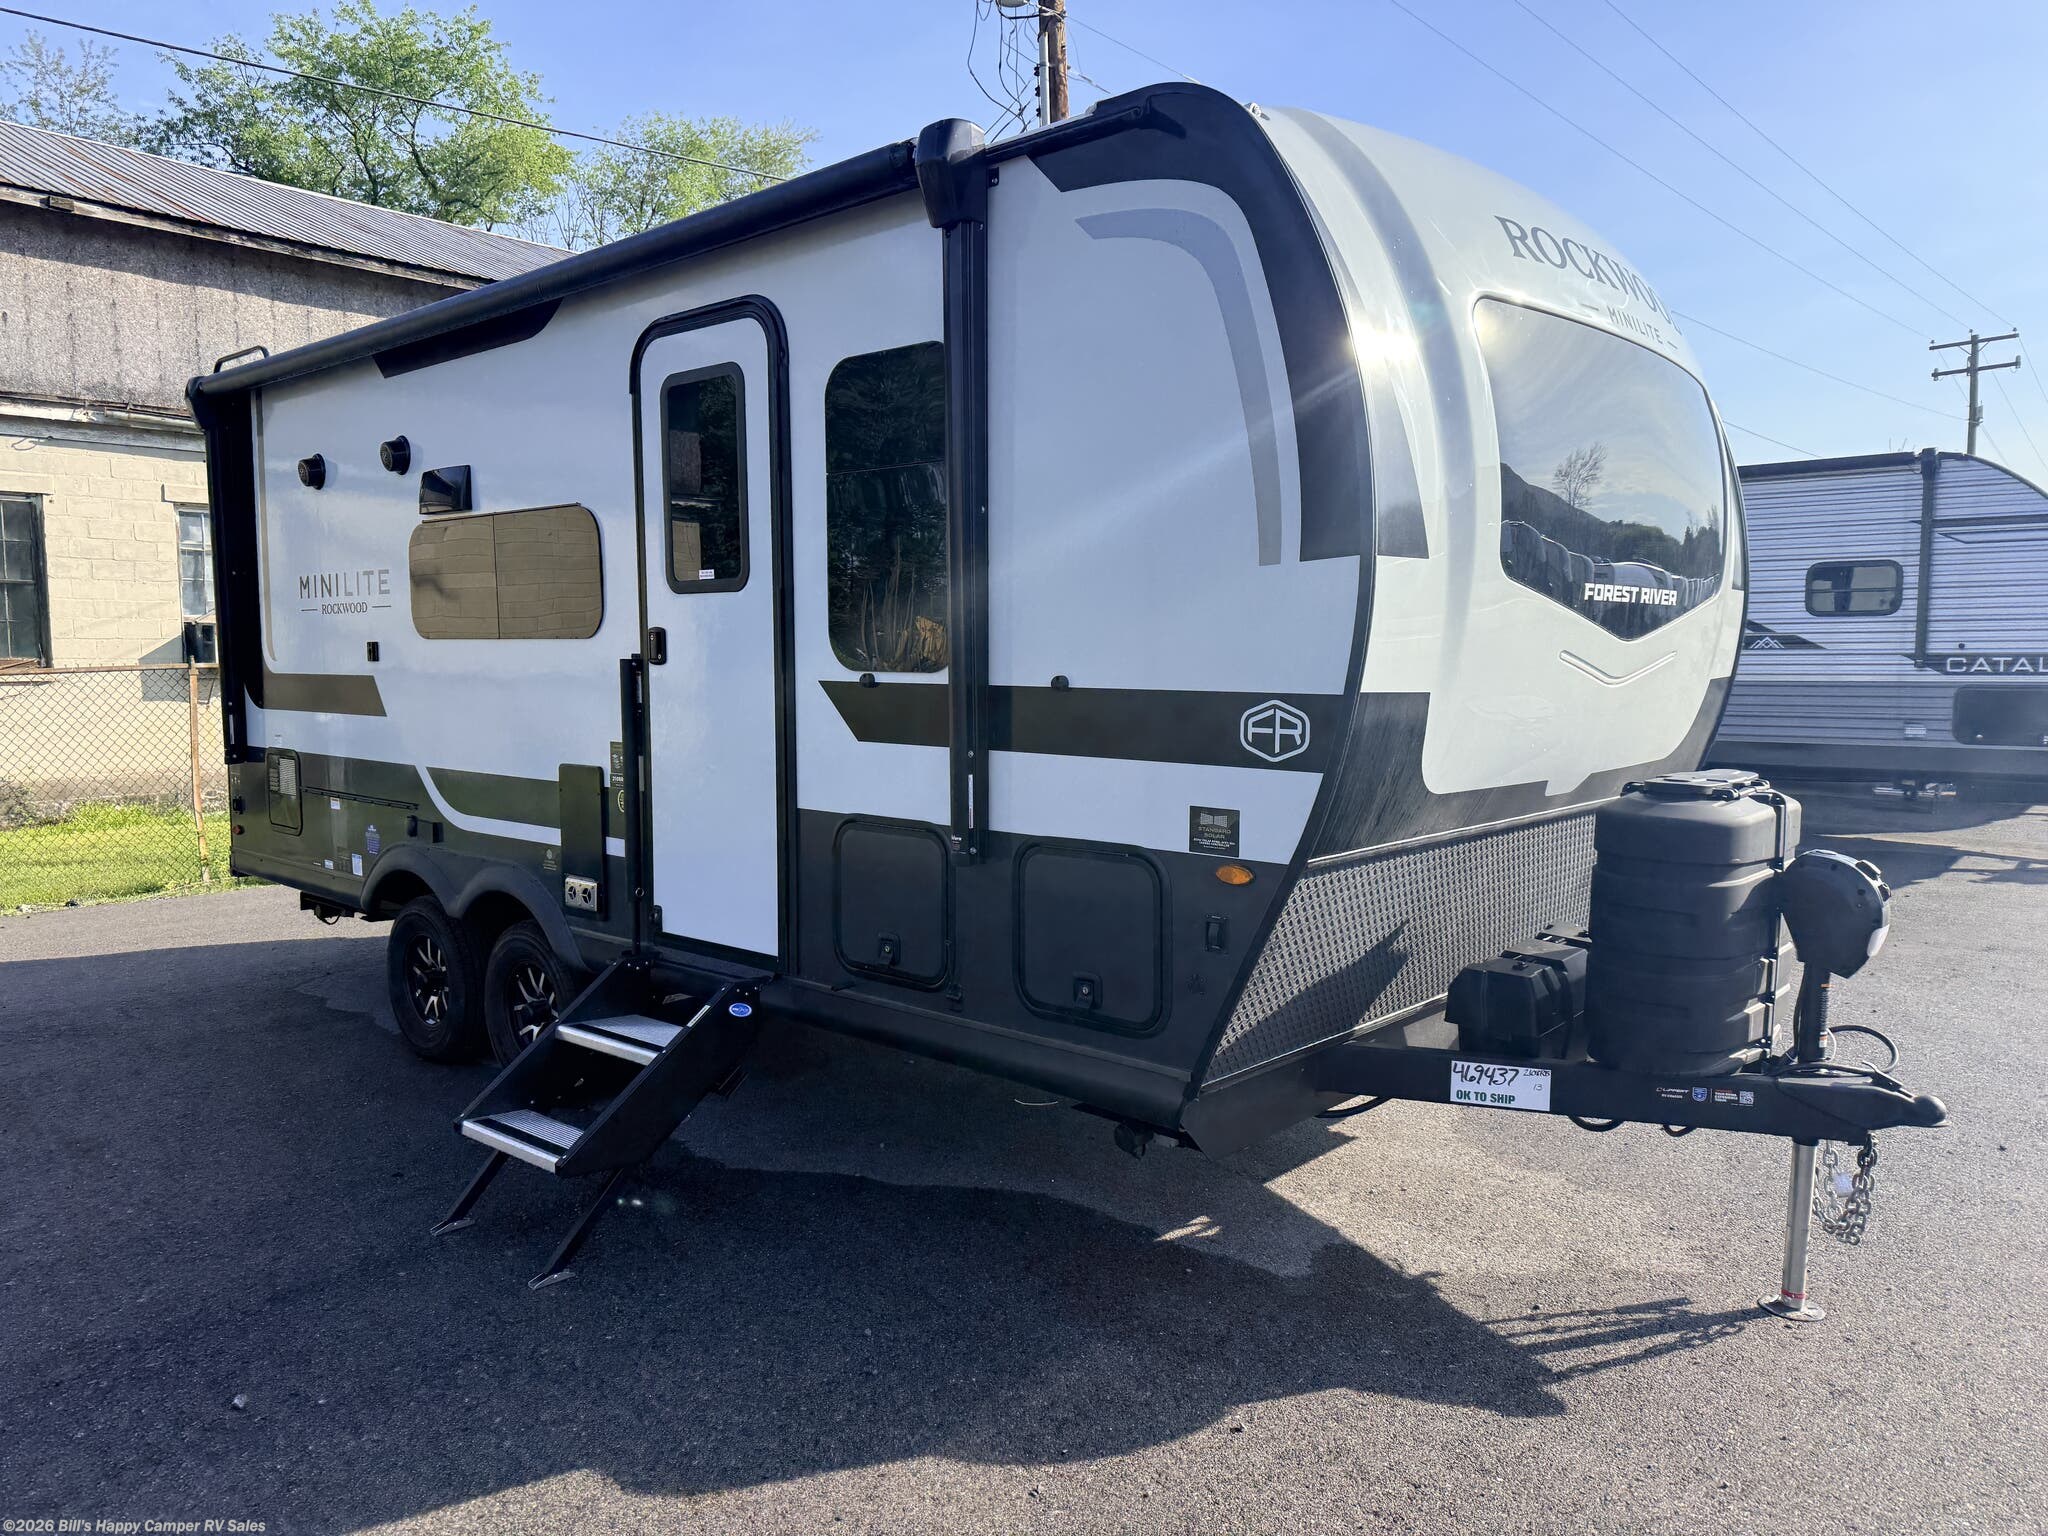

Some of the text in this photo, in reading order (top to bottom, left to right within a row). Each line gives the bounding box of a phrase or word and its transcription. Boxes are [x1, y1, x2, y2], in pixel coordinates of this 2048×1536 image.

[1607, 305, 1664, 345] MINILITE
[299, 568, 391, 600] MINILITE
[1583, 582, 1678, 606] FOREST RIVER
[321, 601, 368, 615] ROCKWOOD
[1946, 656, 2048, 673] CATAL
[1452, 1062, 1520, 1087] 469437
[1456, 1089, 1516, 1105] OK TO SHIP
